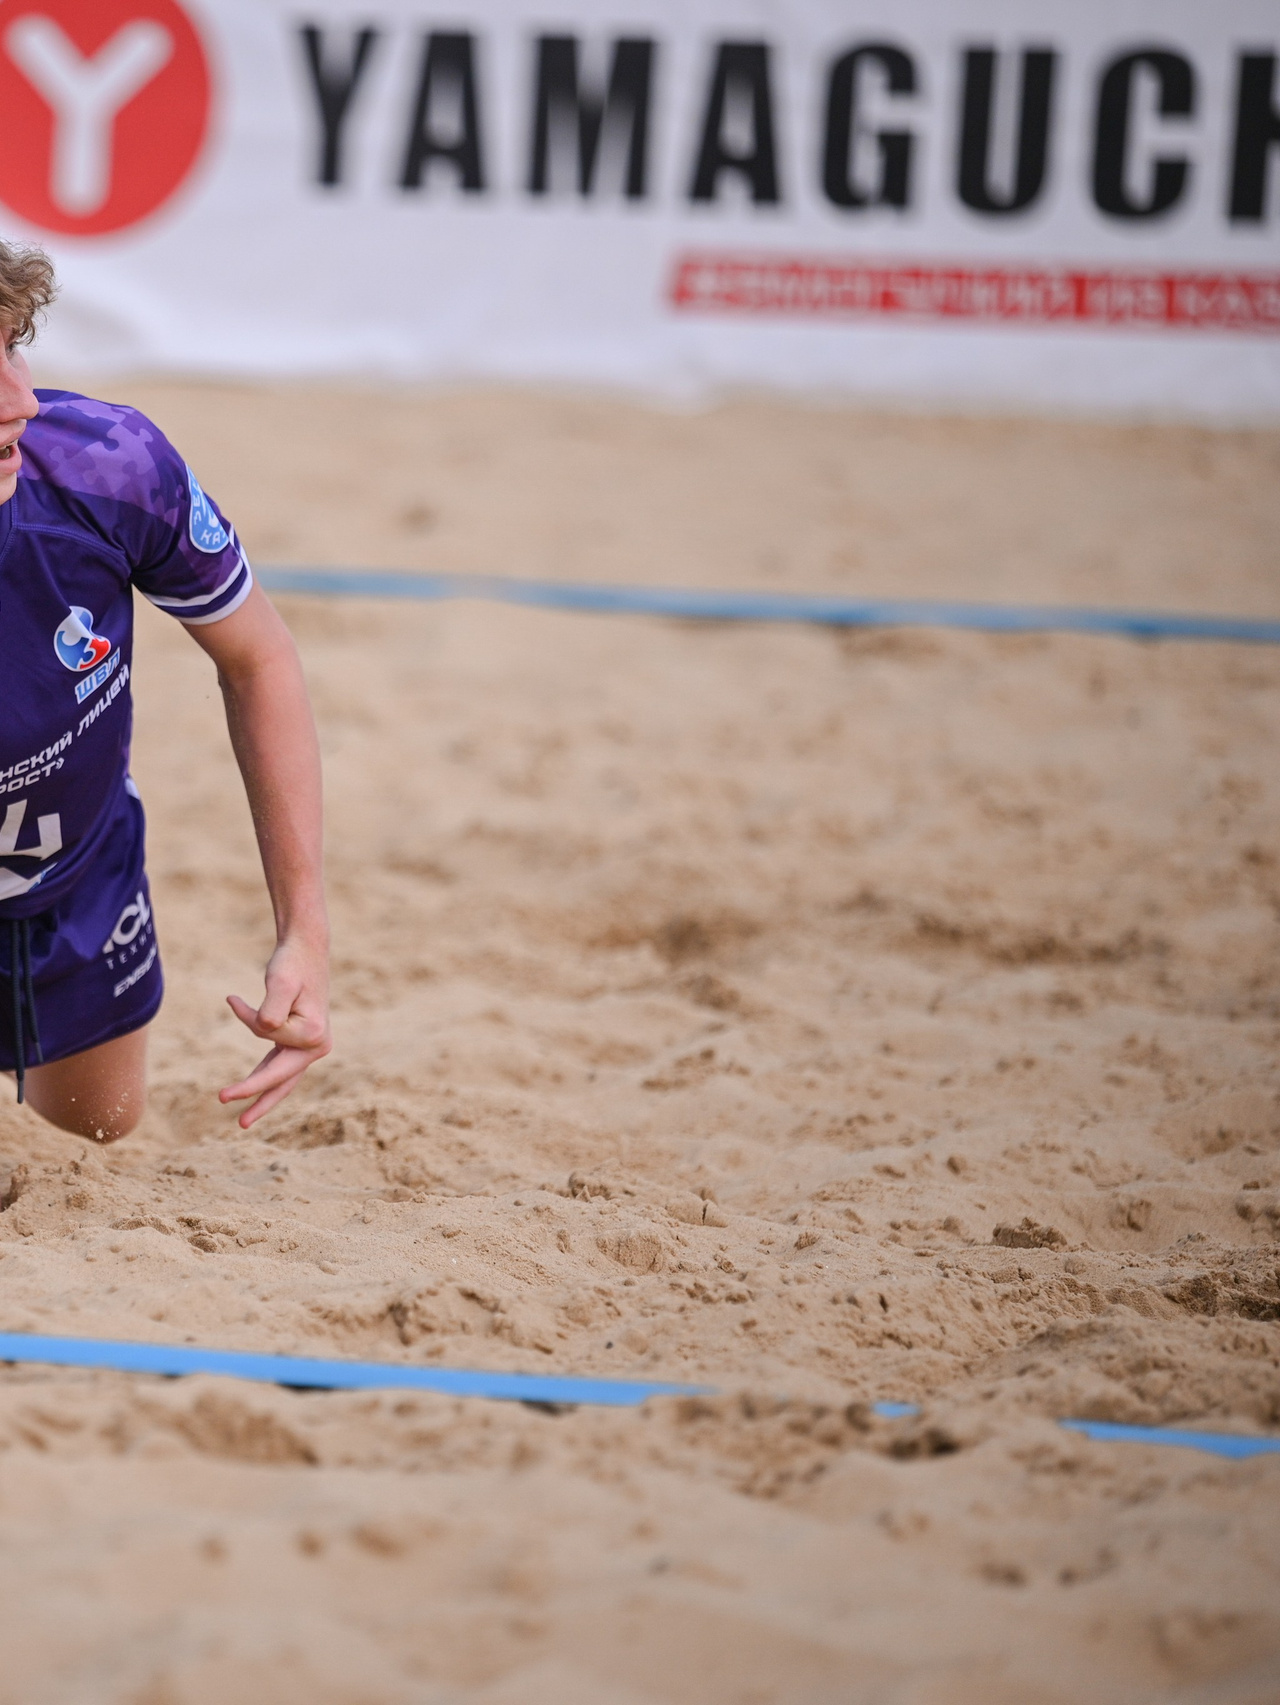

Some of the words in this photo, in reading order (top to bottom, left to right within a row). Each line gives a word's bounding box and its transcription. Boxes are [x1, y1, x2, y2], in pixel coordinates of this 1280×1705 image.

[2, 10, 176, 220] Y
[75, 647, 121, 705] ШВЛ
[77, 663, 130, 737] ЛИЦЕЙ
